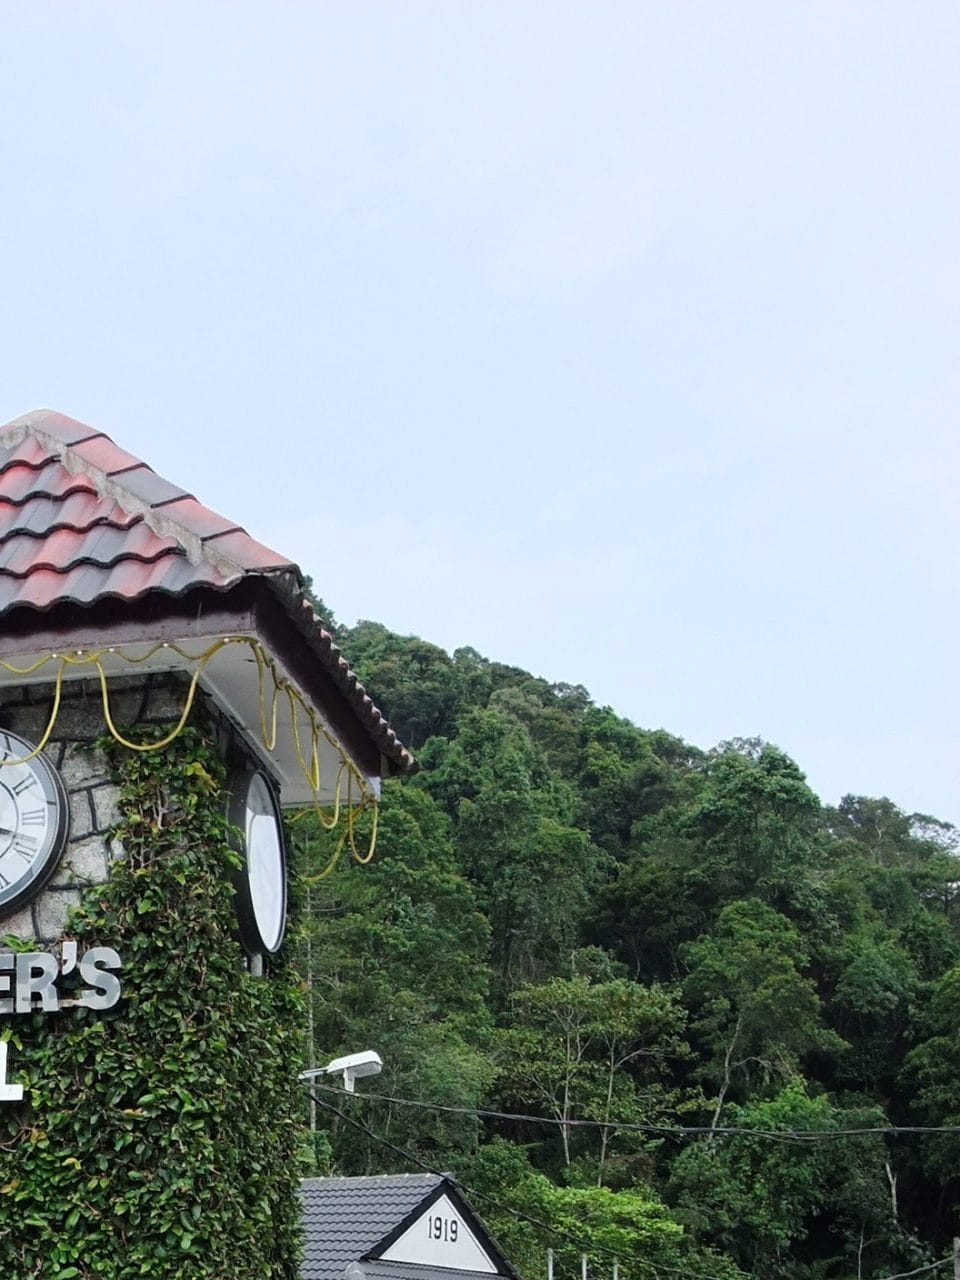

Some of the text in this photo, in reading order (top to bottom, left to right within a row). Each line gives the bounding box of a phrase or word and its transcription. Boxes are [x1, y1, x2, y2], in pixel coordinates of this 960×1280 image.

[12, 772, 38, 796] II
[22, 808, 45, 827] III
[428, 1215, 458, 1243] 1919
